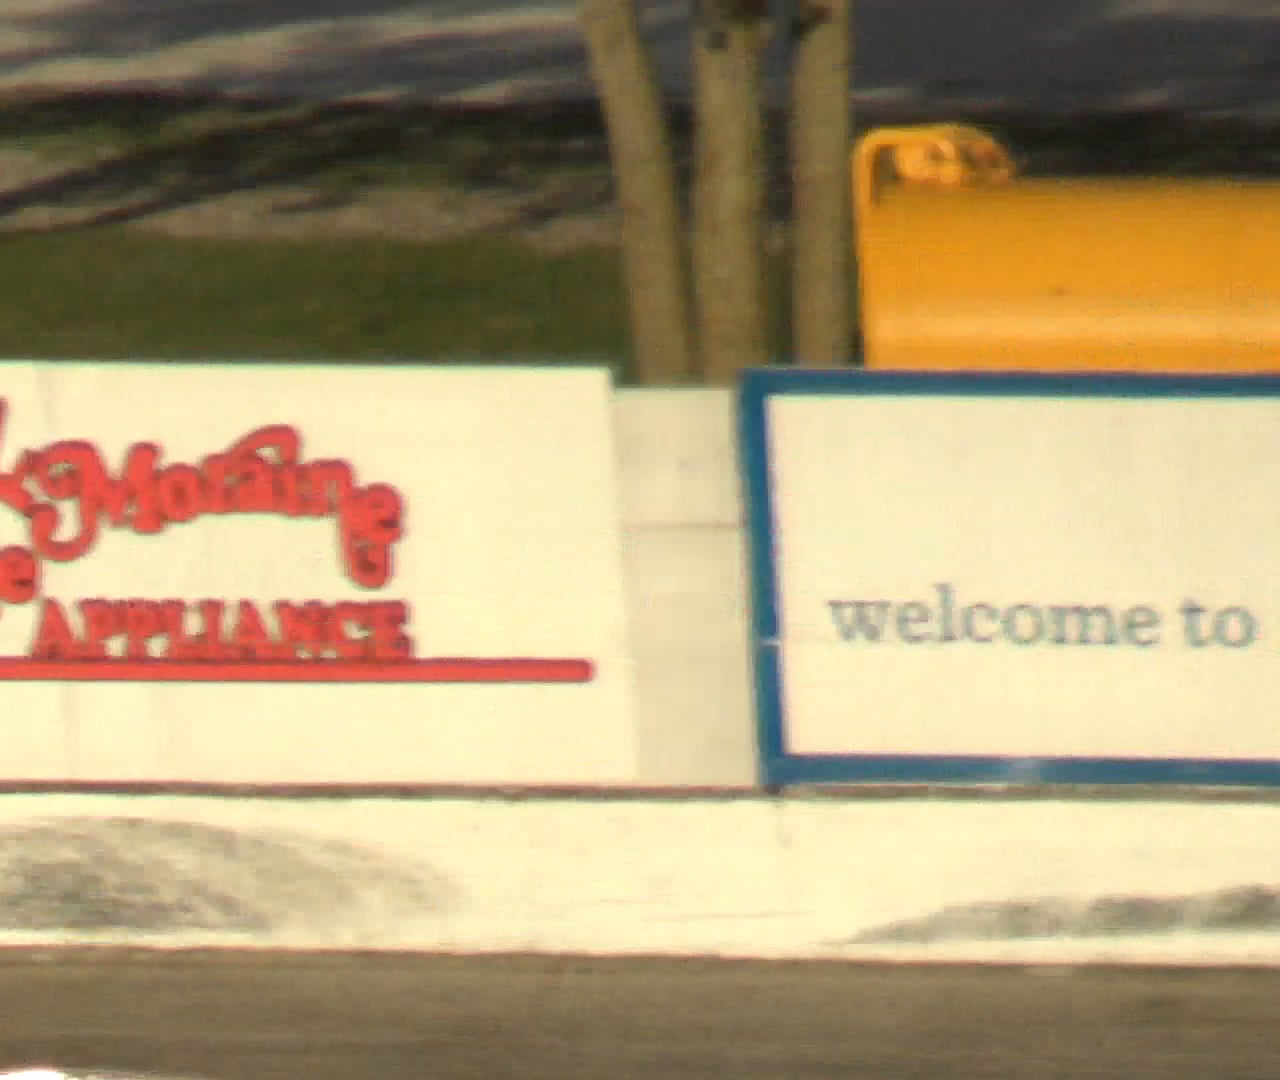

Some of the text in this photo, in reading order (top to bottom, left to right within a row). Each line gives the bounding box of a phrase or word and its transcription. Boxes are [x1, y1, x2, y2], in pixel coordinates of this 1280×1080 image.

[25, 424, 403, 589] Moraine
[32, 600, 413, 660] APPLIANCE
[827, 583, 1259, 648] welcome to
